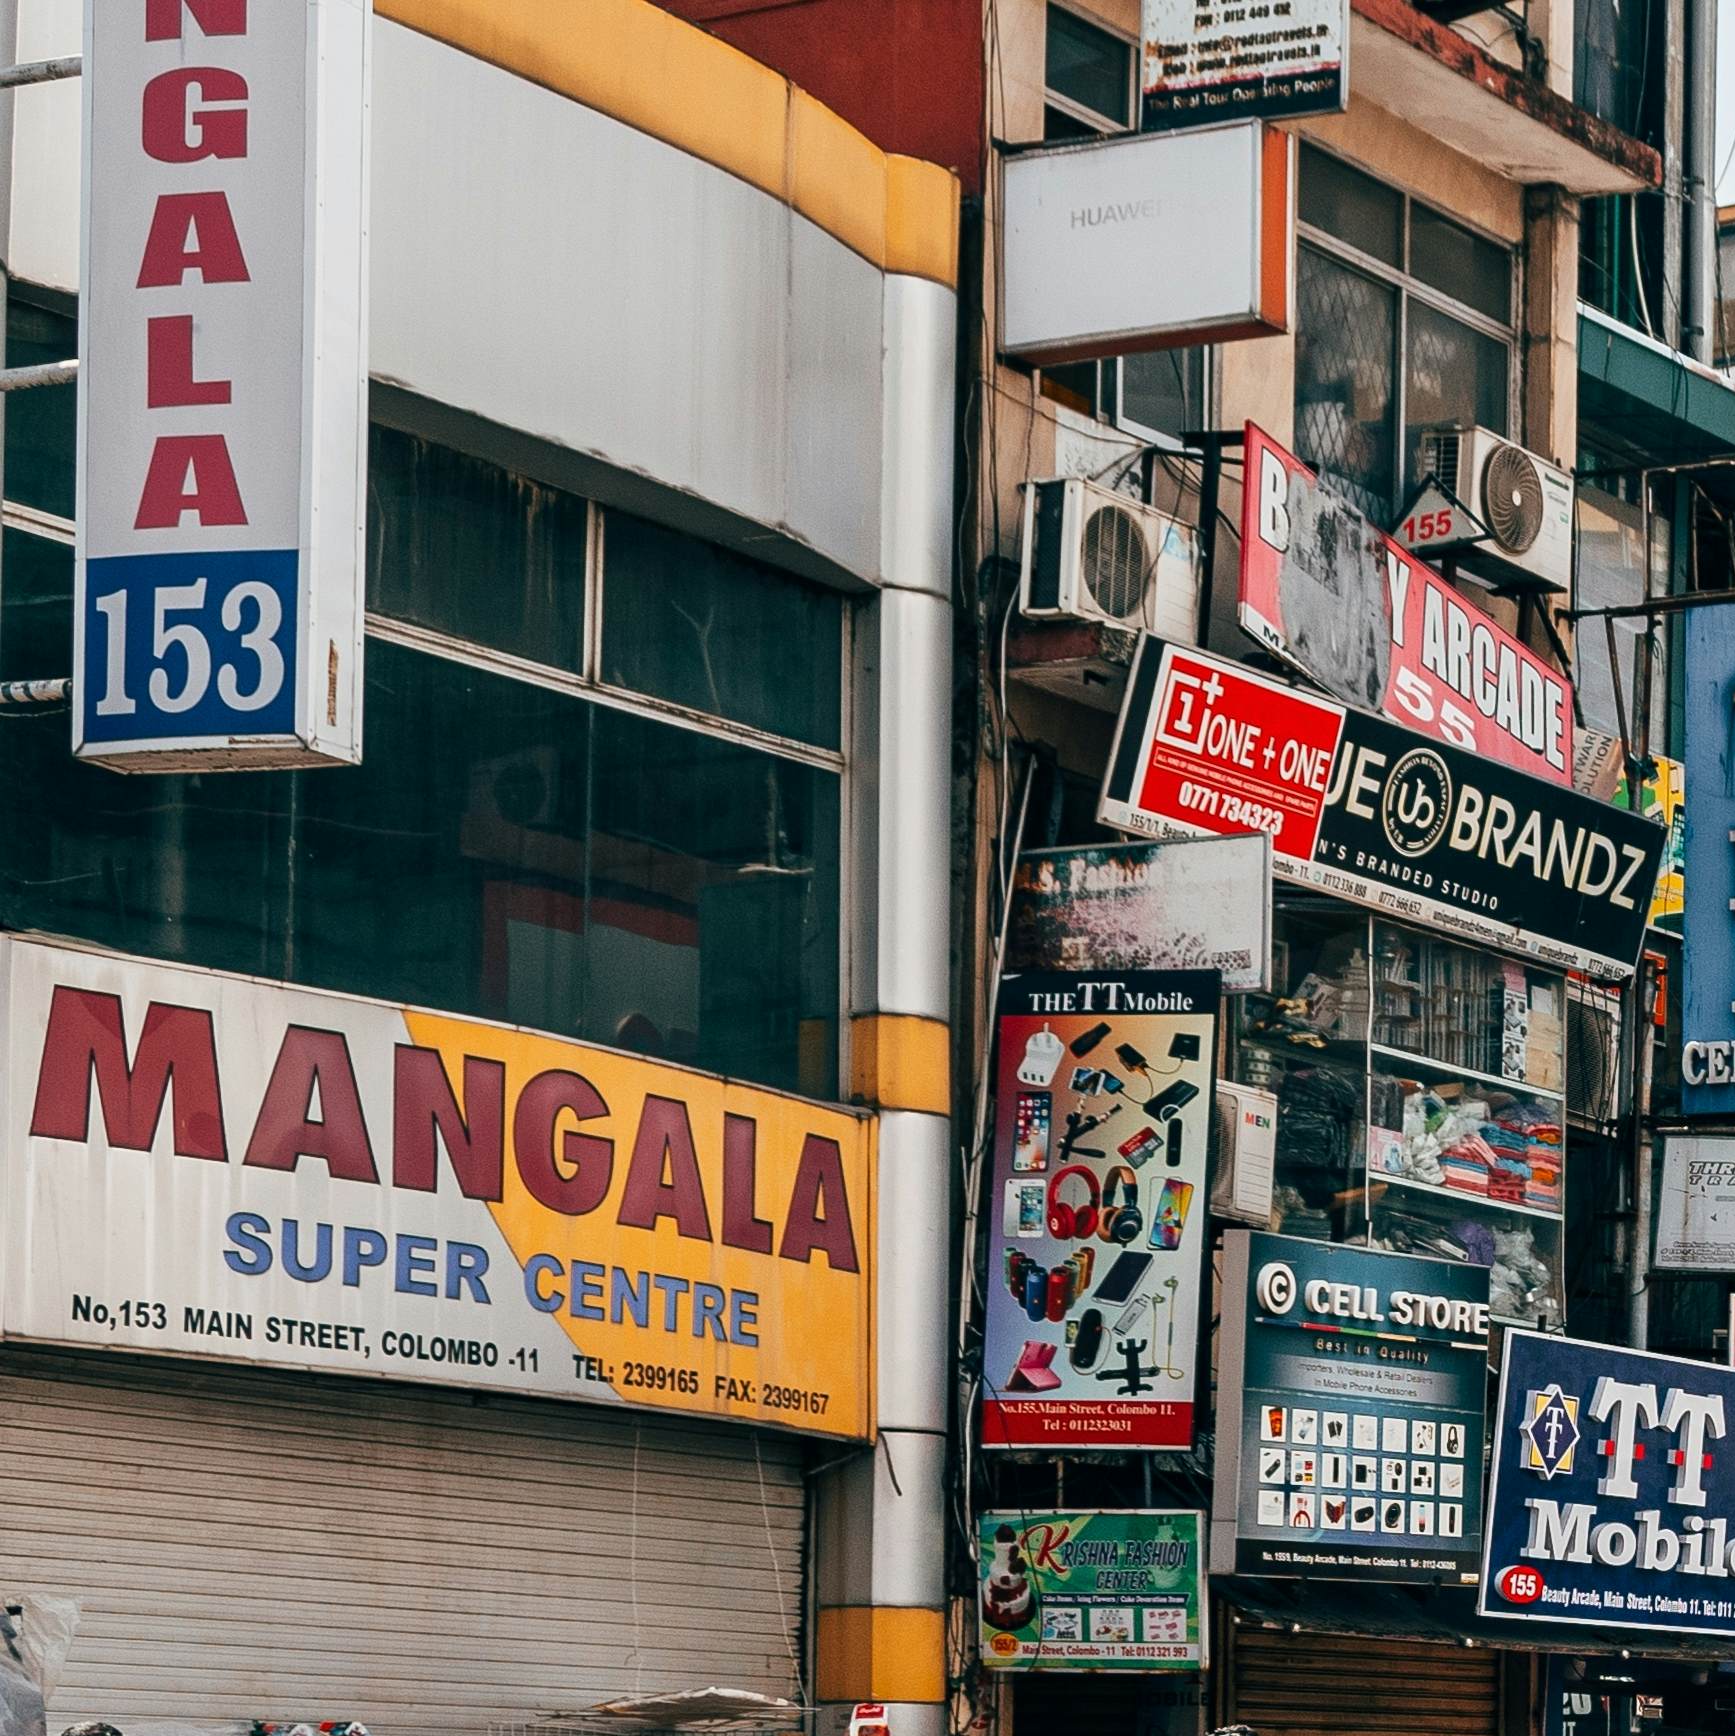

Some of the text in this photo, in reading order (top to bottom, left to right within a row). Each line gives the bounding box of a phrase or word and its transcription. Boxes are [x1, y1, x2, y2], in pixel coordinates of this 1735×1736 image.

[1403, 510, 1452, 543] 155
[95, 577, 283, 716] 153
[1422, 581, 1566, 773] ARCADE
[1206, 714, 1262, 768] ONE
[1279, 739, 1331, 792] ONE
[1449, 784, 1647, 910] BRANDZ
[1356, 851, 1433, 889] BRANDED
[1442, 880, 1499, 911] STUDIO
[1029, 983, 1193, 1012] THE TT Mobile
[29, 983, 861, 1275] MANGALA
[1245, 1112, 1271, 1129] MEN
[222, 1209, 761, 1349] SUPER CENTRE
[1305, 1280, 1490, 1335] CELL STORE
[71, 1294, 830, 1417] No,153 MAIN STREET, COLOMBO TEL: 2399165 FAX: 2399167
[1108, 1404, 1156, 1416] Colombo
[1588, 1376, 1726, 1507] TT
[1020, 1523, 1189, 1575] KRISHNA FASHION
[1096, 1569, 1148, 1590] CENTER
[1509, 1573, 1687, 1614] 155 Beauty Arcade, Main Street, Colombo
[1067, 1644, 1100, 1656] Colombo
